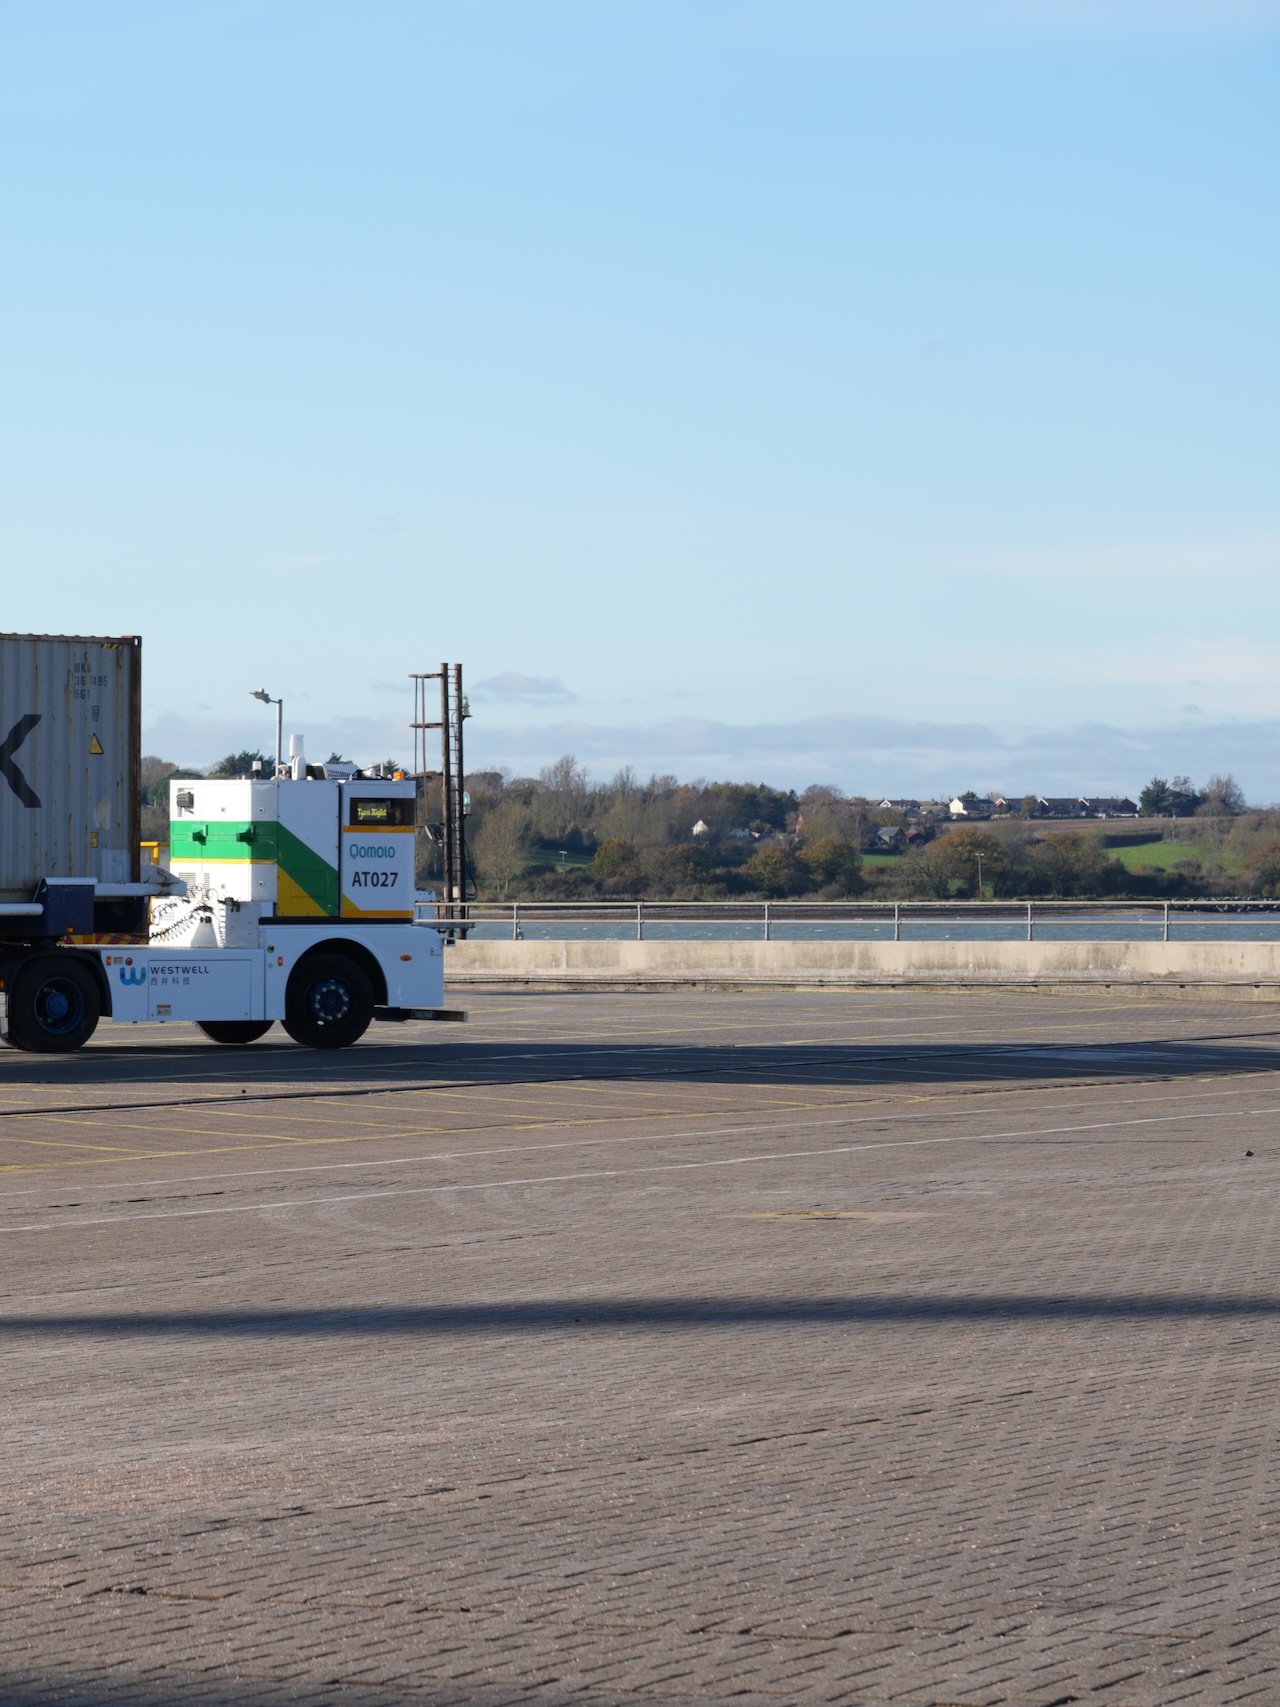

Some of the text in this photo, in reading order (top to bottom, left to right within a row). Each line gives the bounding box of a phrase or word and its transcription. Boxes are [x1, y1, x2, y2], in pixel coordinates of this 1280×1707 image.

[350, 843, 396, 860] Qomolo
[352, 871, 399, 888] AT027
[150, 966, 210, 974] WESTWELL
[150, 976, 191, 986] 西井科技
